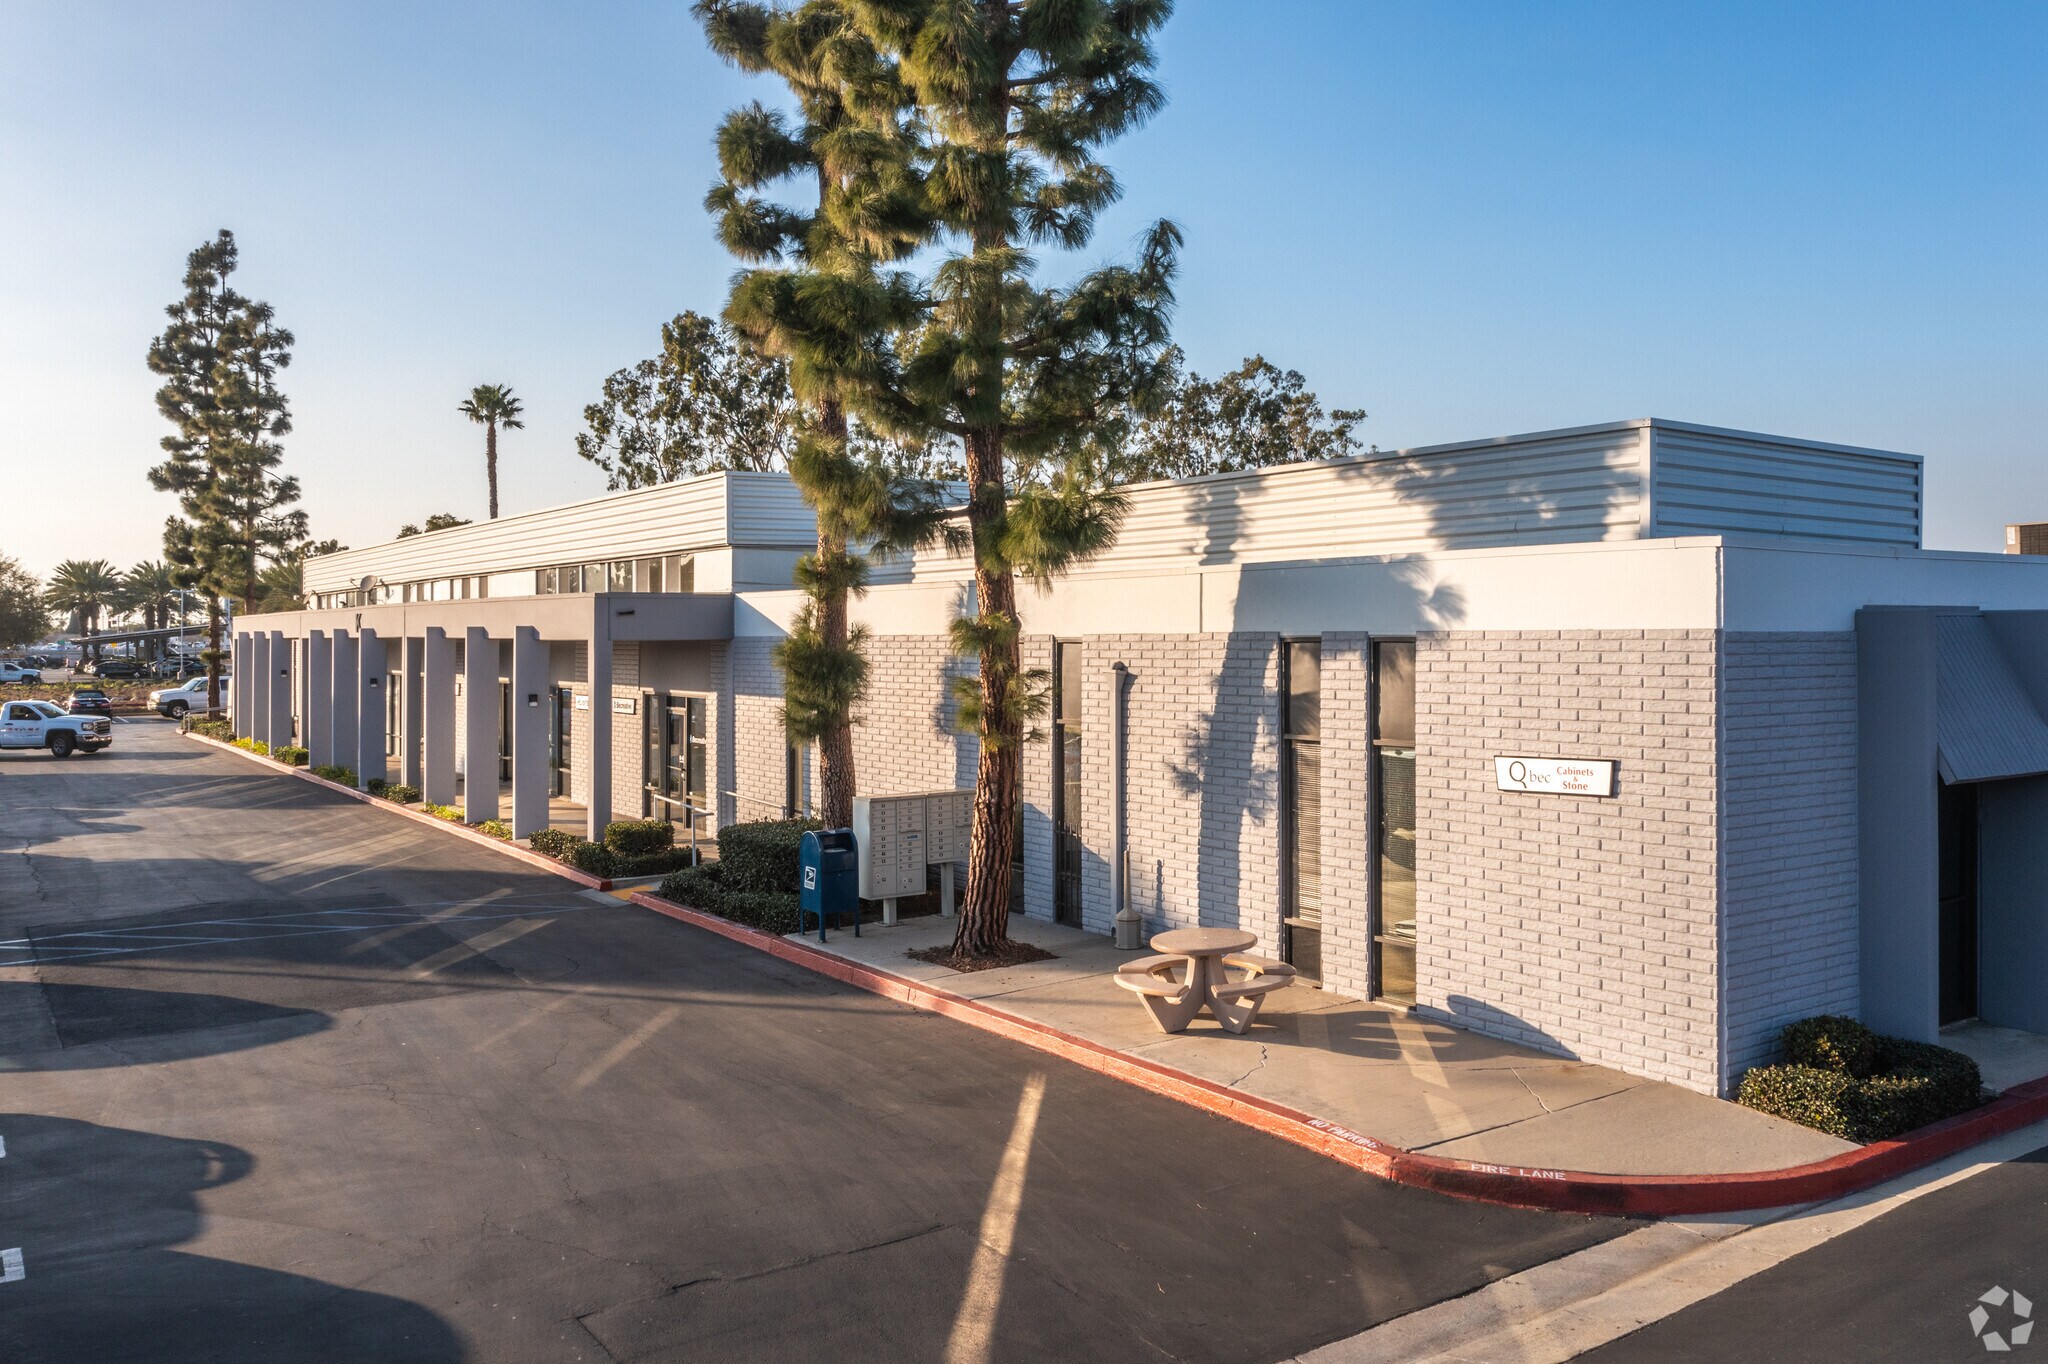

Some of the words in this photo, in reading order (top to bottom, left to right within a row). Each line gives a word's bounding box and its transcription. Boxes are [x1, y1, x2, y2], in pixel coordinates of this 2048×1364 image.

[1556, 766, 1594, 777] Cabinets
[1562, 781, 1589, 791] Stone
[1307, 1119, 1330, 1128] NO
[1471, 1163, 1510, 1175] FIRE
[1520, 1168, 1567, 1180] LANE
